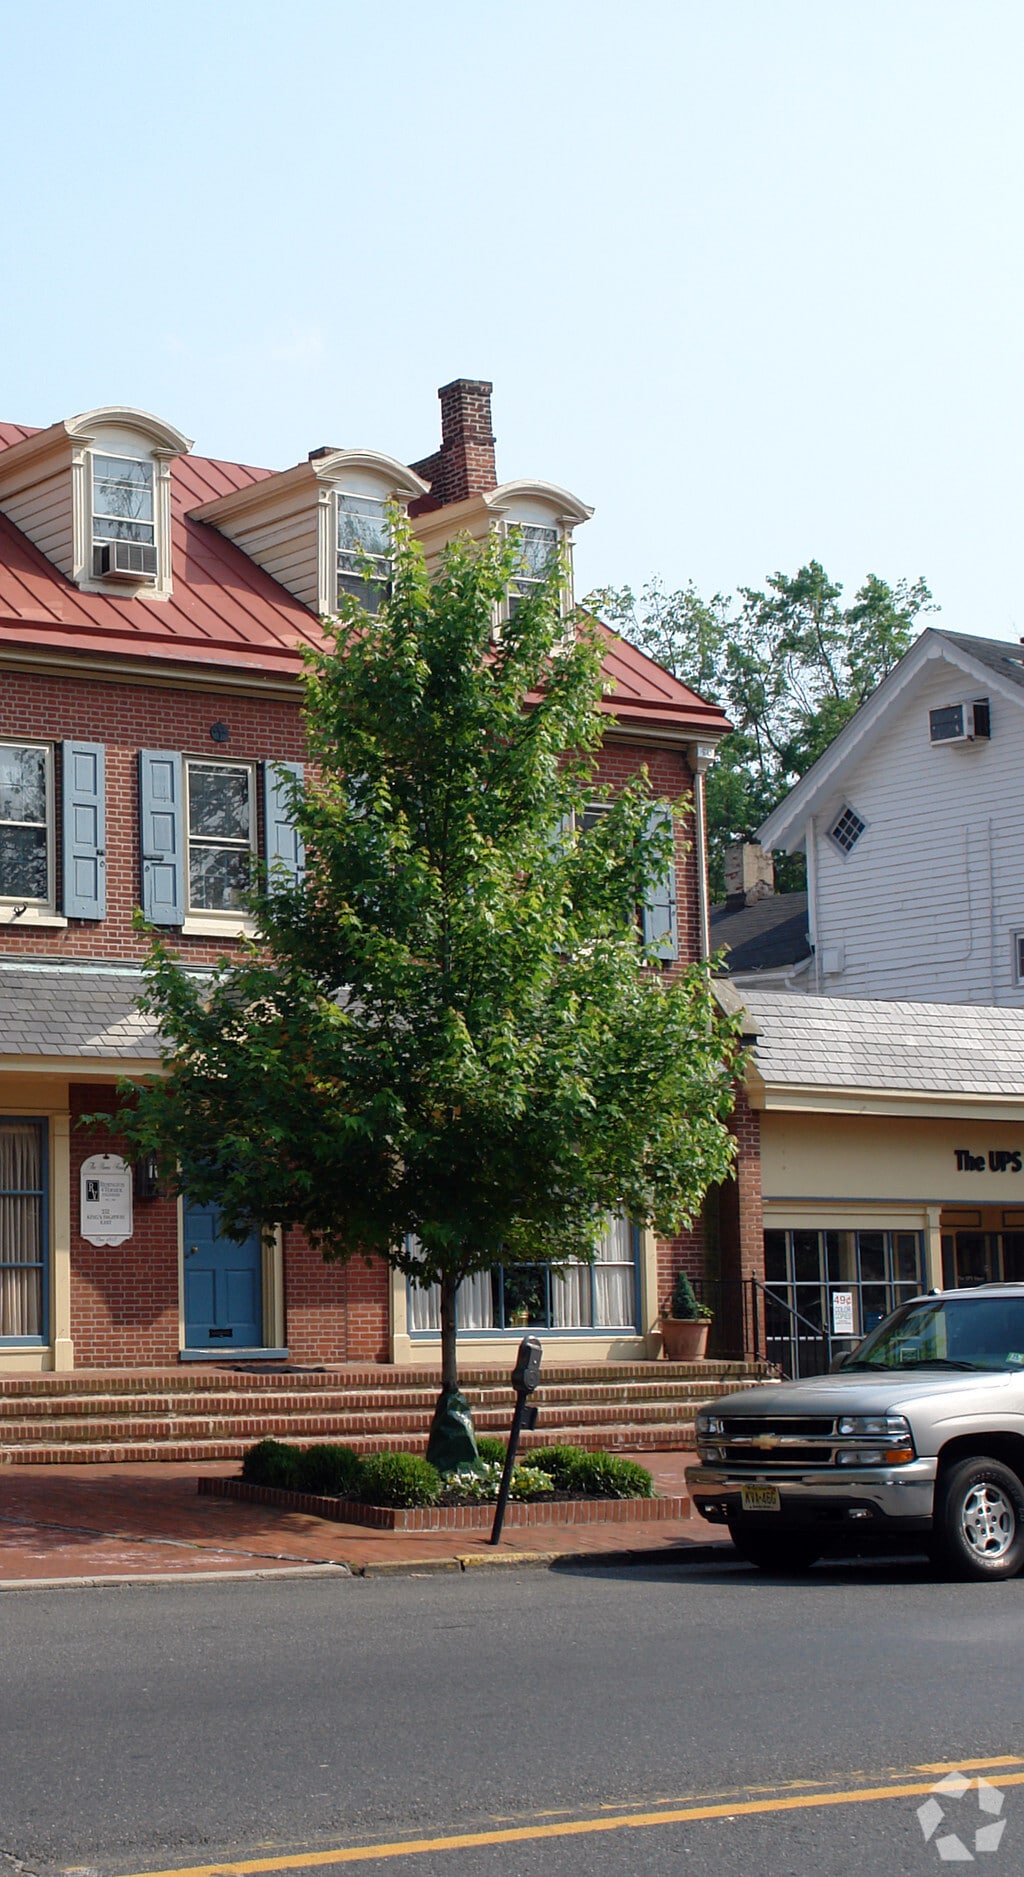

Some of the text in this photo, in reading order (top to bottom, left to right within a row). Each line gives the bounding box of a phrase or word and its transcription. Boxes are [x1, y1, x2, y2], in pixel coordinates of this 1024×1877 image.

[954, 1149, 1022, 1173] The UPS
[834, 1296, 851, 1305] 49¢
